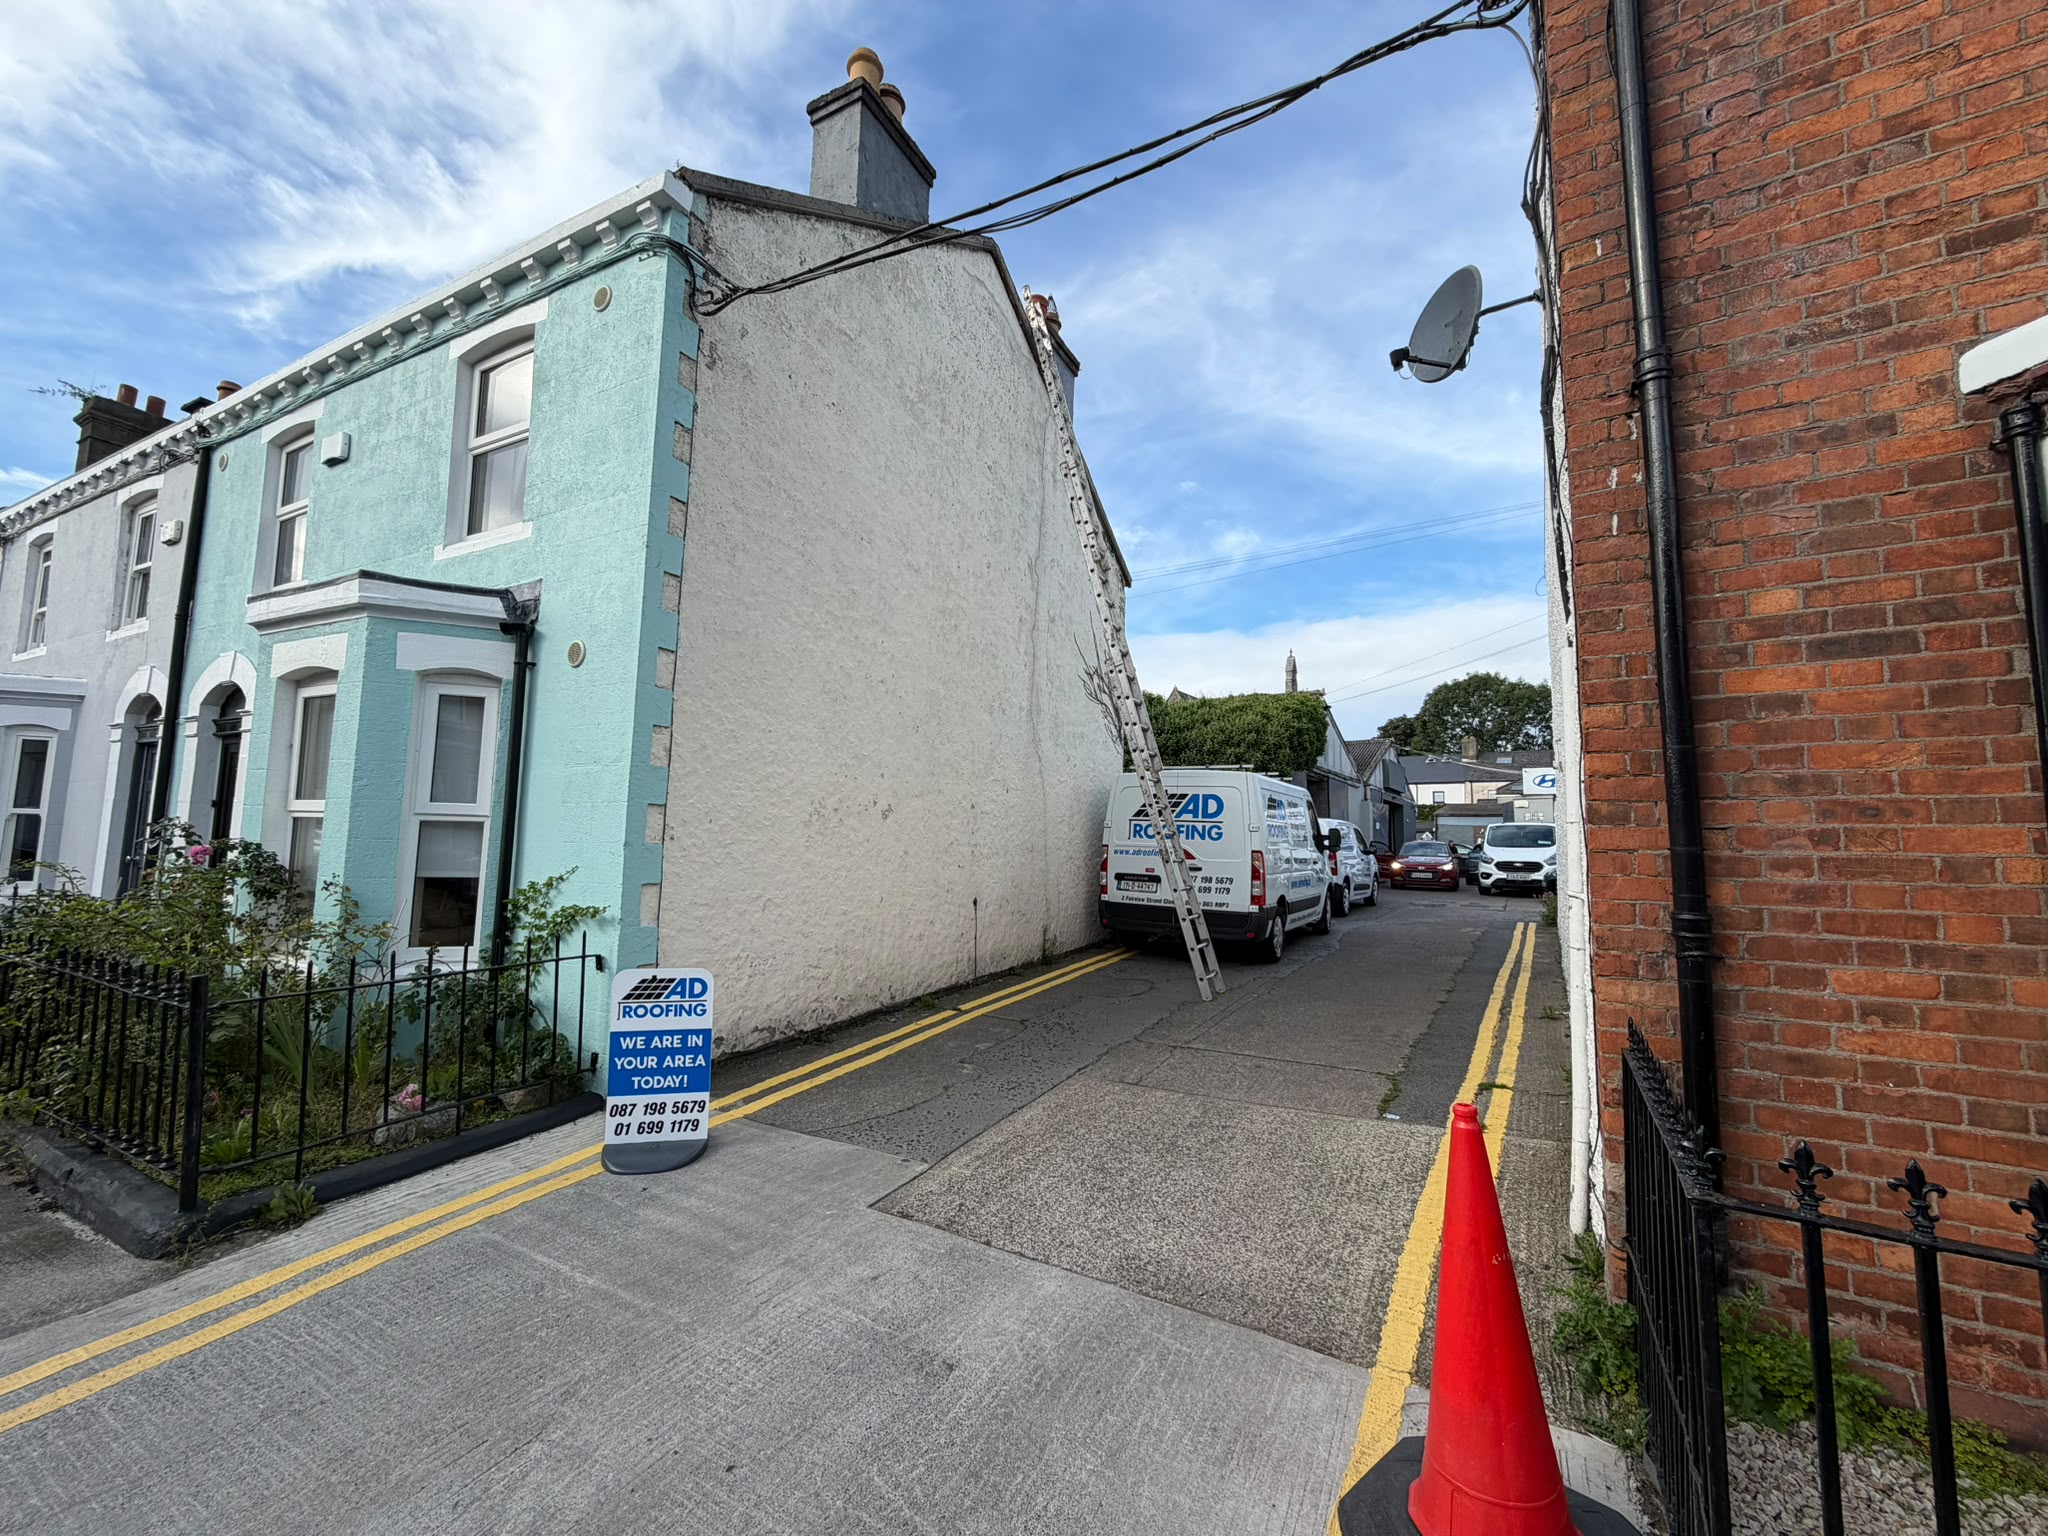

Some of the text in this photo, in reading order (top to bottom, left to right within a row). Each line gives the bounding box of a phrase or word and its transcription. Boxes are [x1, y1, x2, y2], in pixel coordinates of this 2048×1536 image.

[1174, 793, 1225, 819] AD
[1200, 875, 1213, 884] 198
[1215, 876, 1234, 886] 5679
[1198, 886, 1231, 896] 699 1179
[663, 977, 708, 1000] AD
[621, 1003, 707, 1019] ROOFING
[619, 1034, 703, 1050] WE ARE IN
[614, 1054, 706, 1070] YOUR AREA
[631, 1074, 688, 1089] TODAY!
[609, 1099, 706, 1118] 087 198 5679
[614, 1118, 700, 1136] 01 699 1179
